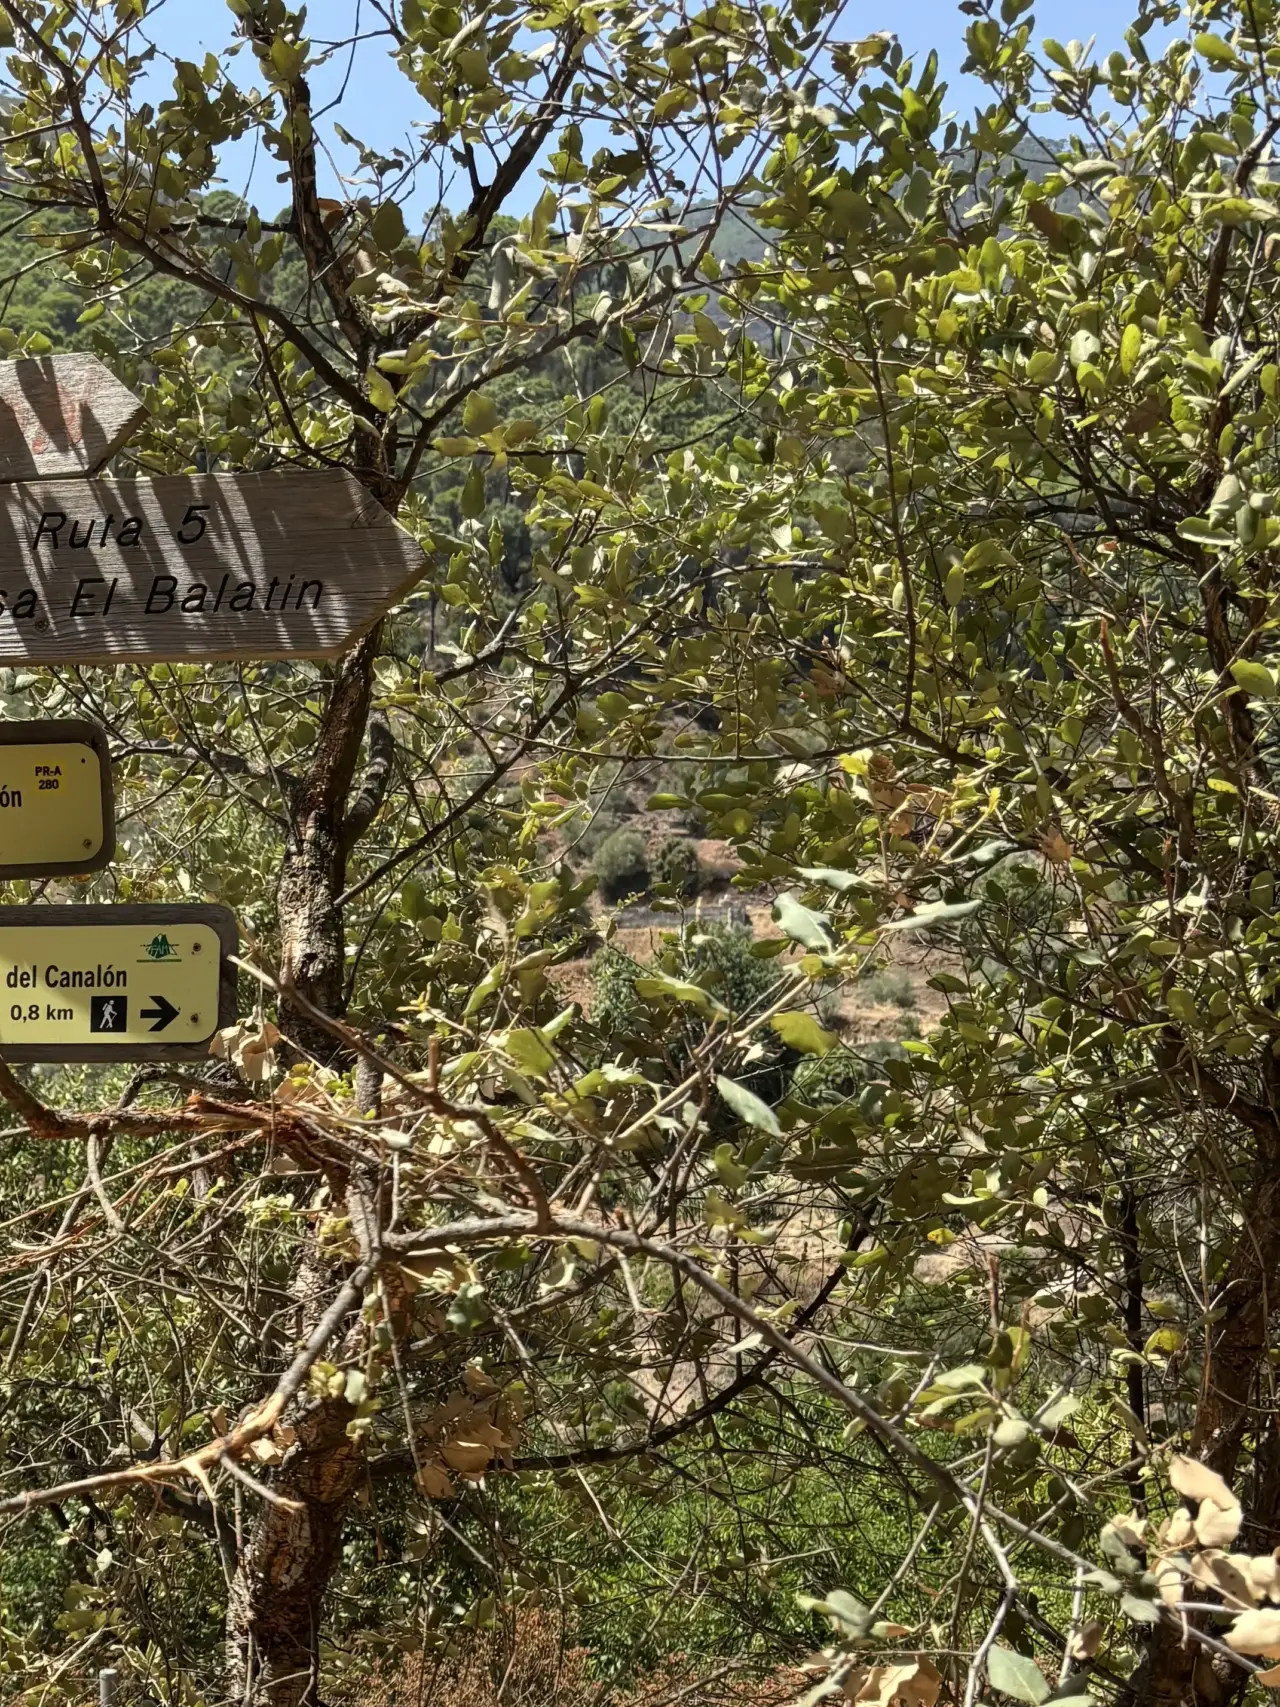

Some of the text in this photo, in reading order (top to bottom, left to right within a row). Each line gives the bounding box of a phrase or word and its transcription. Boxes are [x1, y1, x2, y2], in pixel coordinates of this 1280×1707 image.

[33, 505, 210, 550] Ruta 5
[70, 577, 118, 617] El
[144, 573, 324, 614] Balatin
[35, 765, 62, 776] PR-A
[38, 779, 59, 790] 280
[6, 965, 37, 988] del
[45, 964, 127, 988] Canalón
[10, 1004, 74, 1023] 0,8 km
